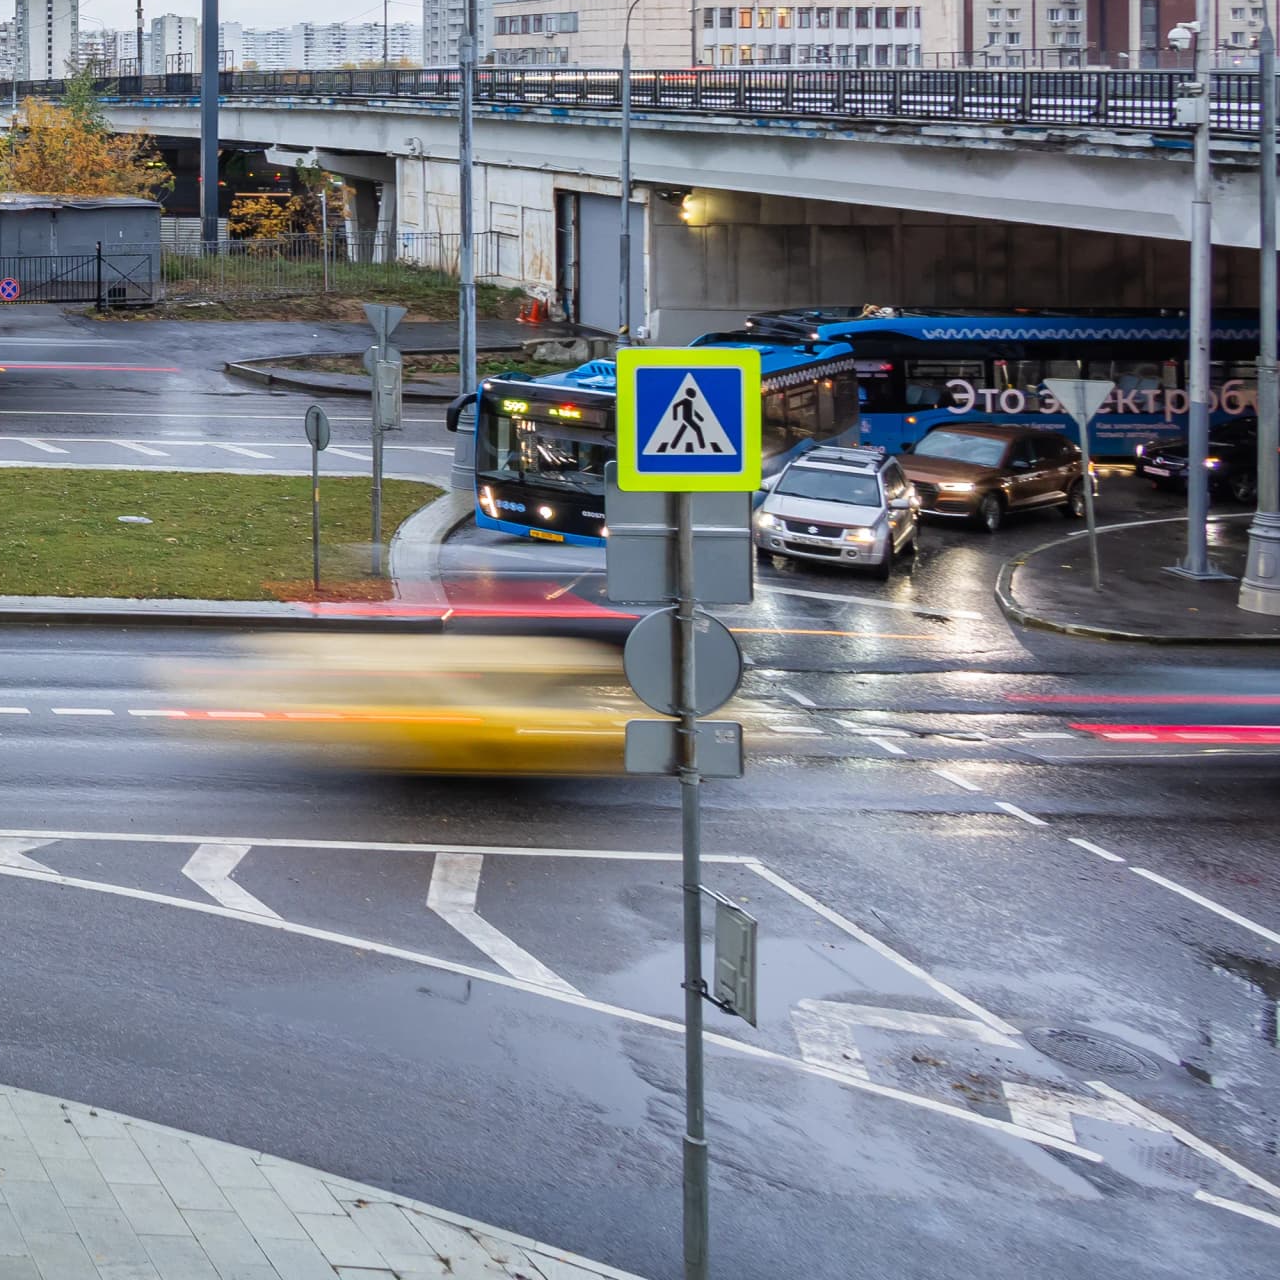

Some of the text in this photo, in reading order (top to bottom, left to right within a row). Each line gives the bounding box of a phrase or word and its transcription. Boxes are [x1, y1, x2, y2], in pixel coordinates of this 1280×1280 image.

[503, 400, 529, 413] 599
[945, 379, 1258, 422] Это эектрб
